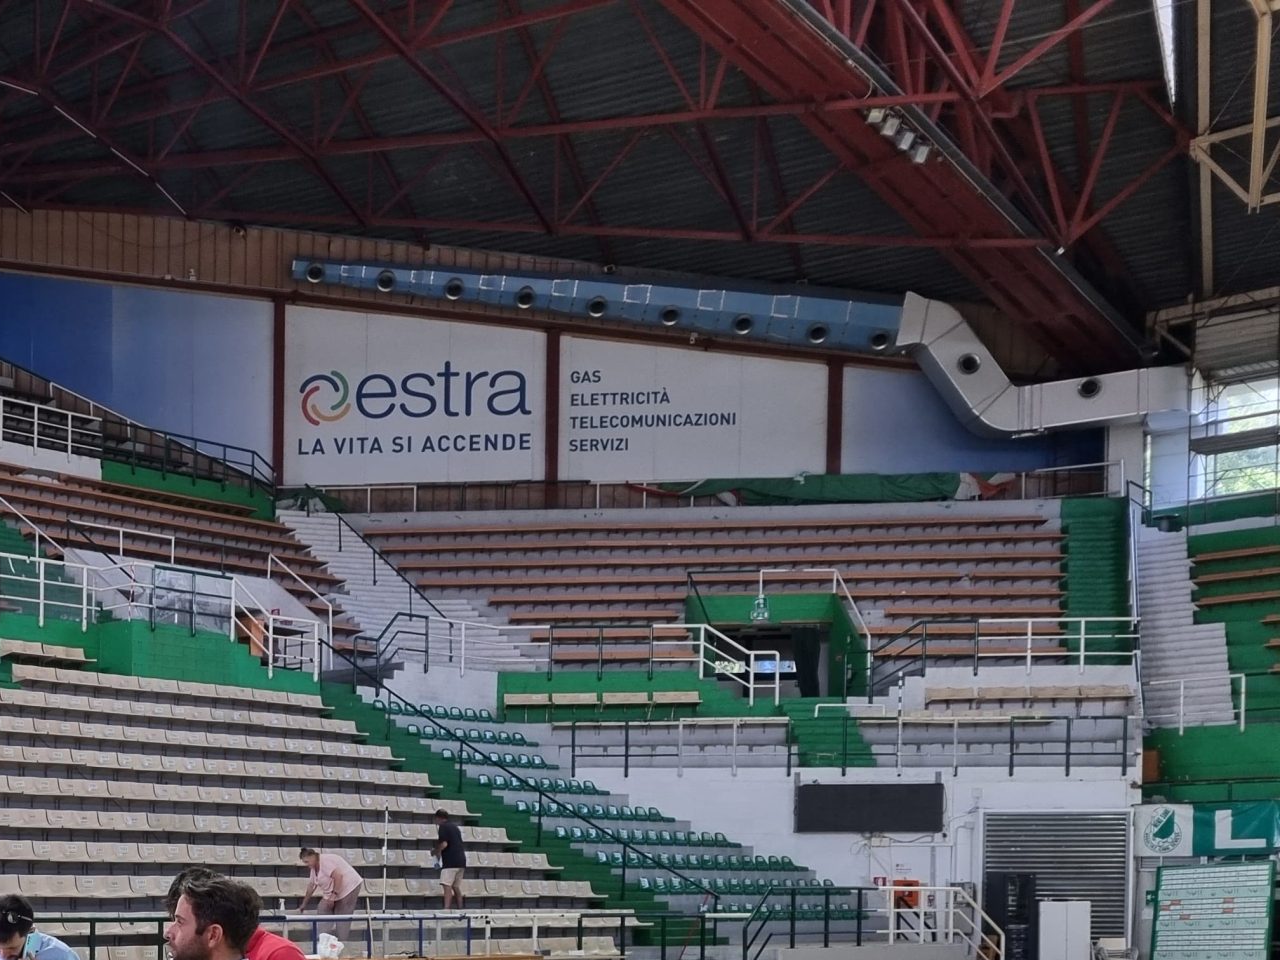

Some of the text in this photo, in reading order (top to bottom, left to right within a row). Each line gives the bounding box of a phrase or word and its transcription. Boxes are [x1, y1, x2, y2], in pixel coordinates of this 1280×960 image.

[570, 370, 602, 384] GAS
[355, 361, 532, 419] estra
[570, 386, 671, 407] ELETTRICITÀ
[569, 413, 737, 430] TELECOMUNICAZIONI
[298, 433, 532, 456] LA VITA SI ACCENDE
[569, 438, 630, 453] SERVIZI
